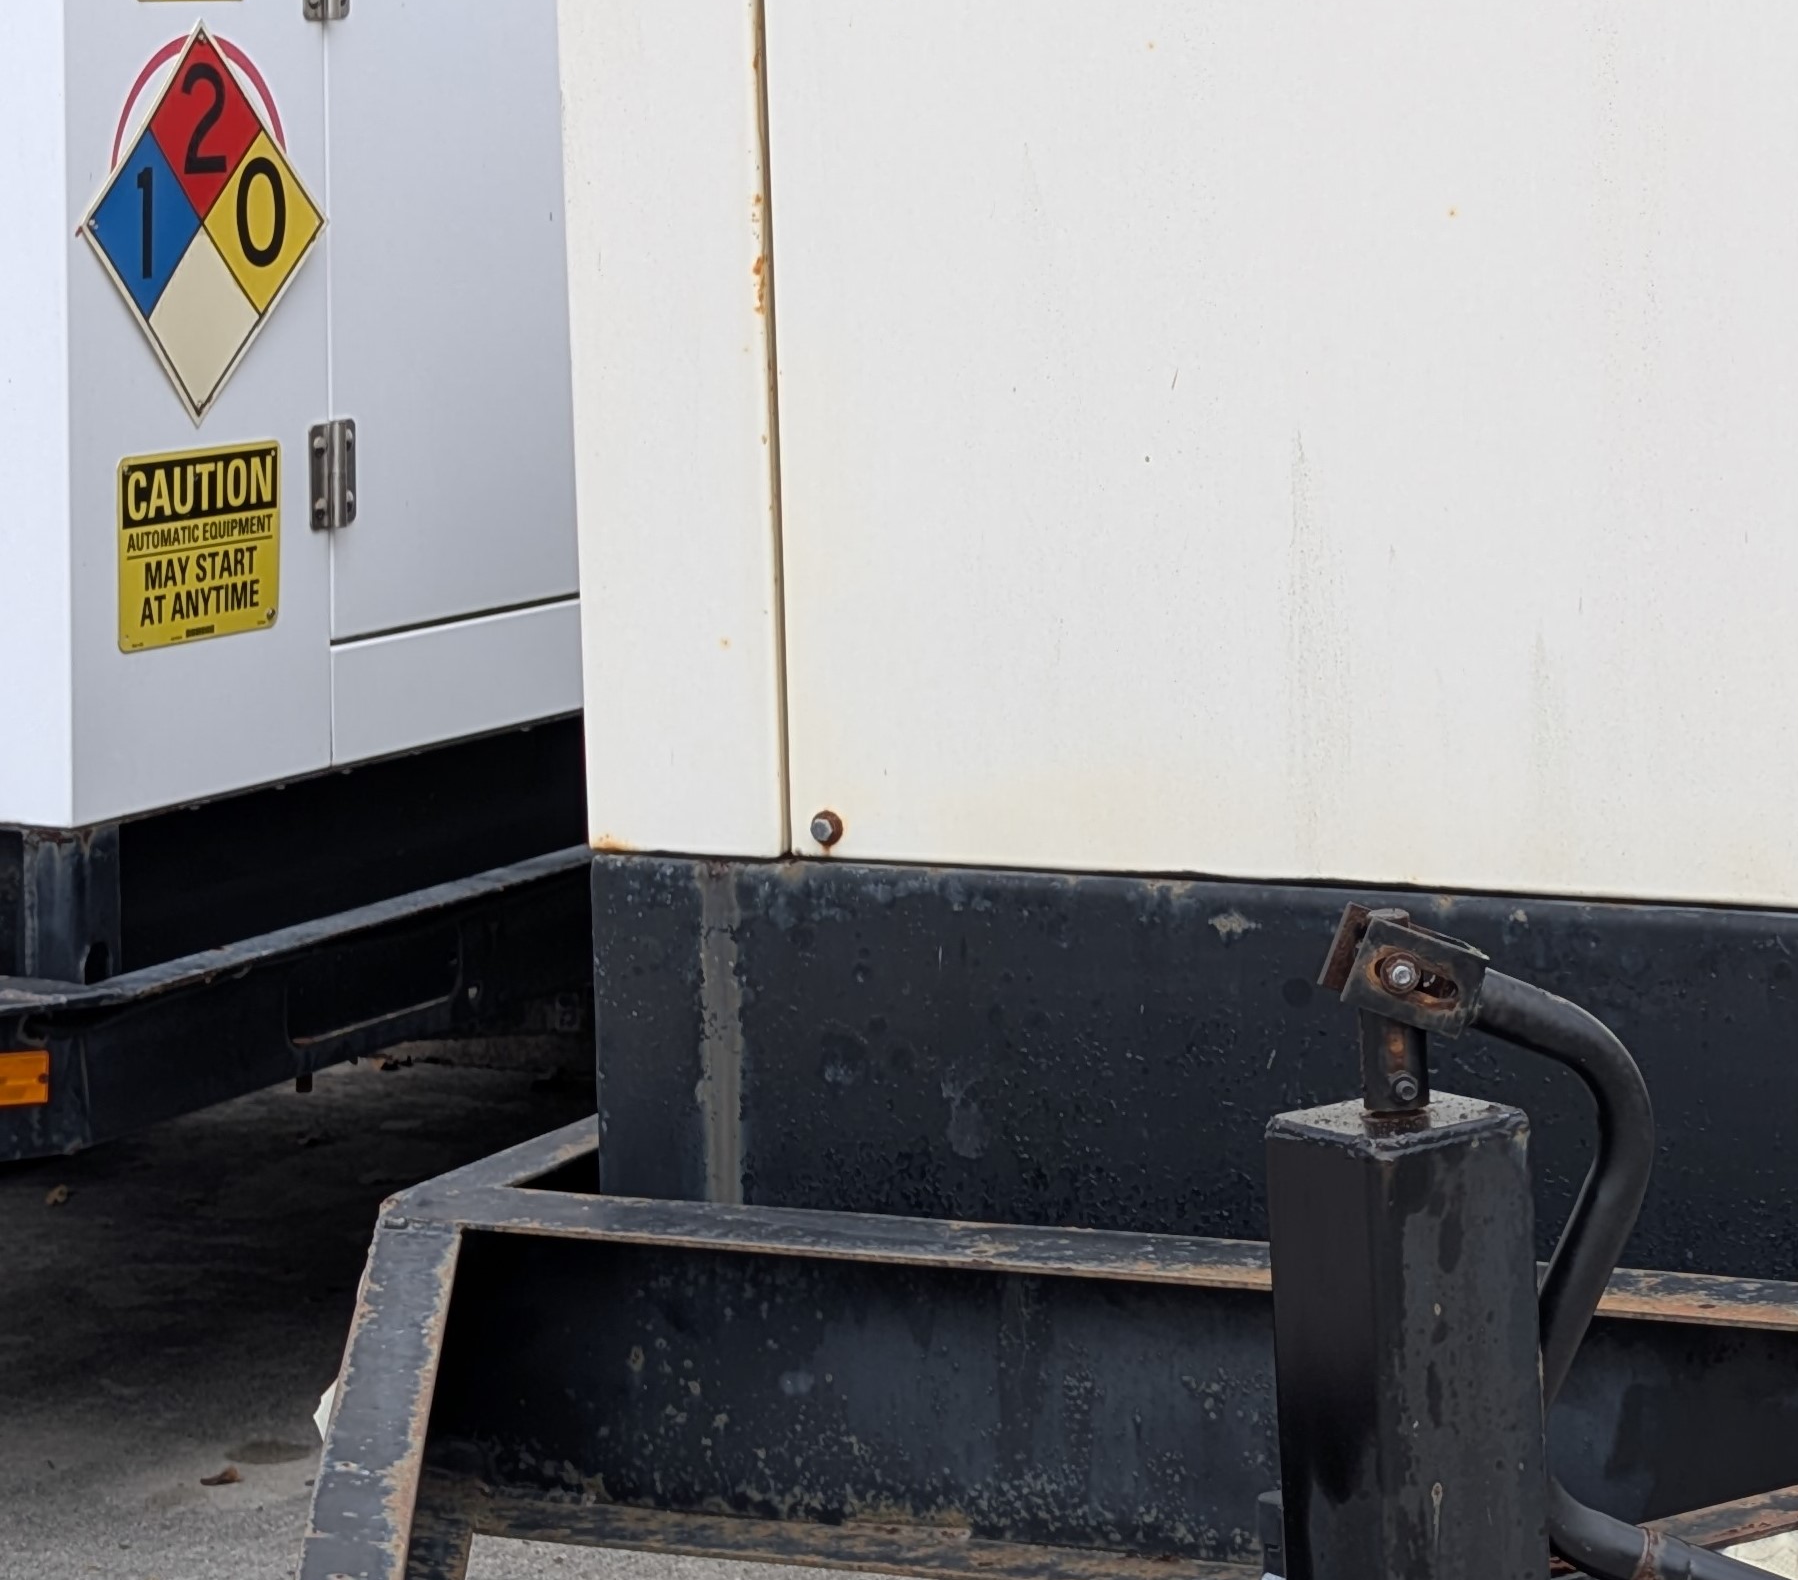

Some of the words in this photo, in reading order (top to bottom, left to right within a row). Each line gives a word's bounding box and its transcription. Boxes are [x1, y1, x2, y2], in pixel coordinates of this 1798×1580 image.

[181, 61, 227, 175] 2
[136, 166, 153, 280] 1
[236, 156, 287, 268] 0
[127, 454, 273, 521] CAUTION
[127, 524, 200, 553] AUTOMATIC
[202, 513, 273, 541] EQUIPMENT
[144, 555, 190, 591] MAY
[195, 545, 257, 583] START
[140, 593, 167, 627] AT
[170, 579, 260, 622] ANYTIME
